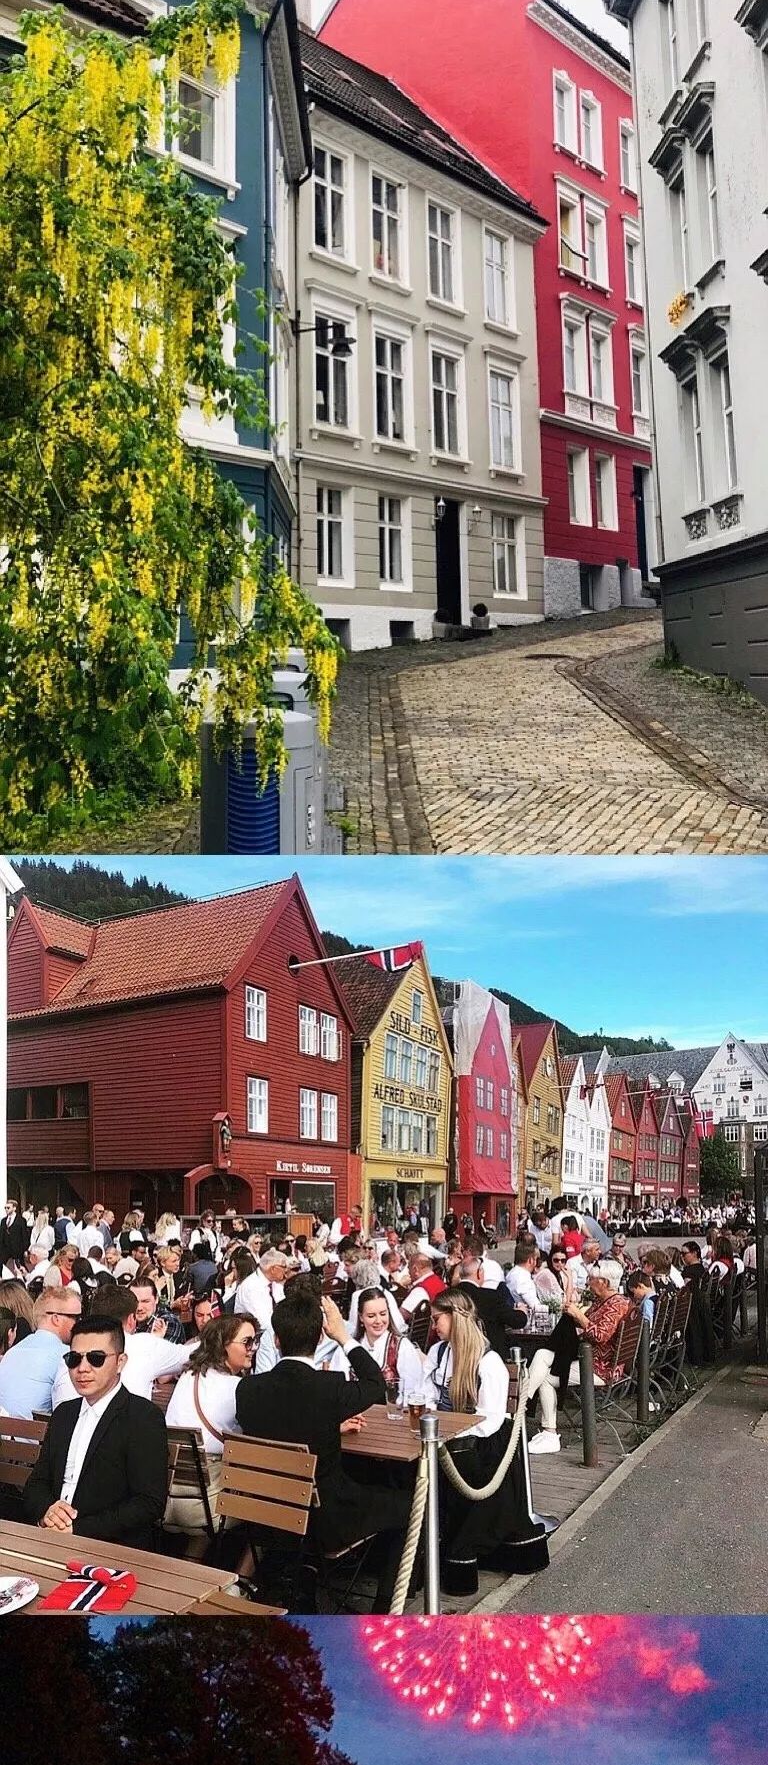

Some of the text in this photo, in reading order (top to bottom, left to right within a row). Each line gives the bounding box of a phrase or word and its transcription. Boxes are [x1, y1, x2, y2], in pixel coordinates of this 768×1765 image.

[390, 1010, 439, 1047] SILD FISK
[373, 1083, 405, 1104] ALFRED
